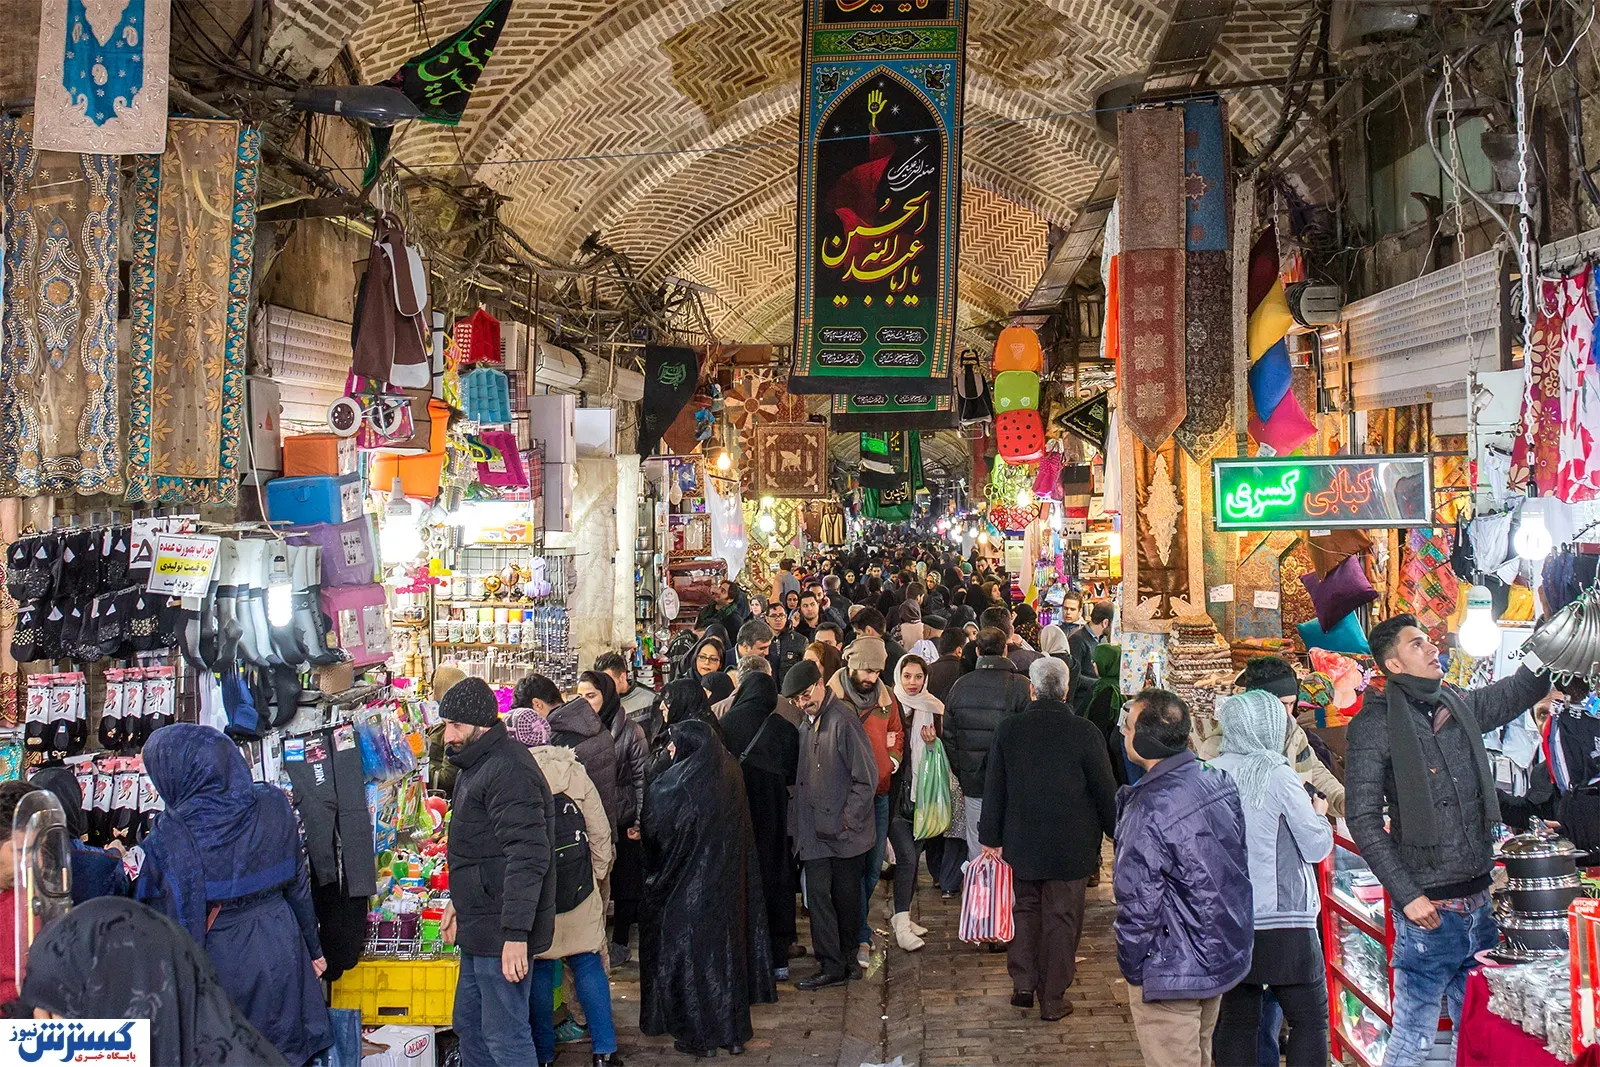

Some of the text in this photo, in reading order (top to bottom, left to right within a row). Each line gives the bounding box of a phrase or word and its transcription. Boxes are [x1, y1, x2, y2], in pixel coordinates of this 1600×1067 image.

[1226, 468, 1374, 518] کبابی کسری
[159, 542, 175, 552] عمده
[196, 543, 215, 558] جوراب
[160, 561, 183, 572] تولیدی
[313, 763, 326, 786] NIKE
